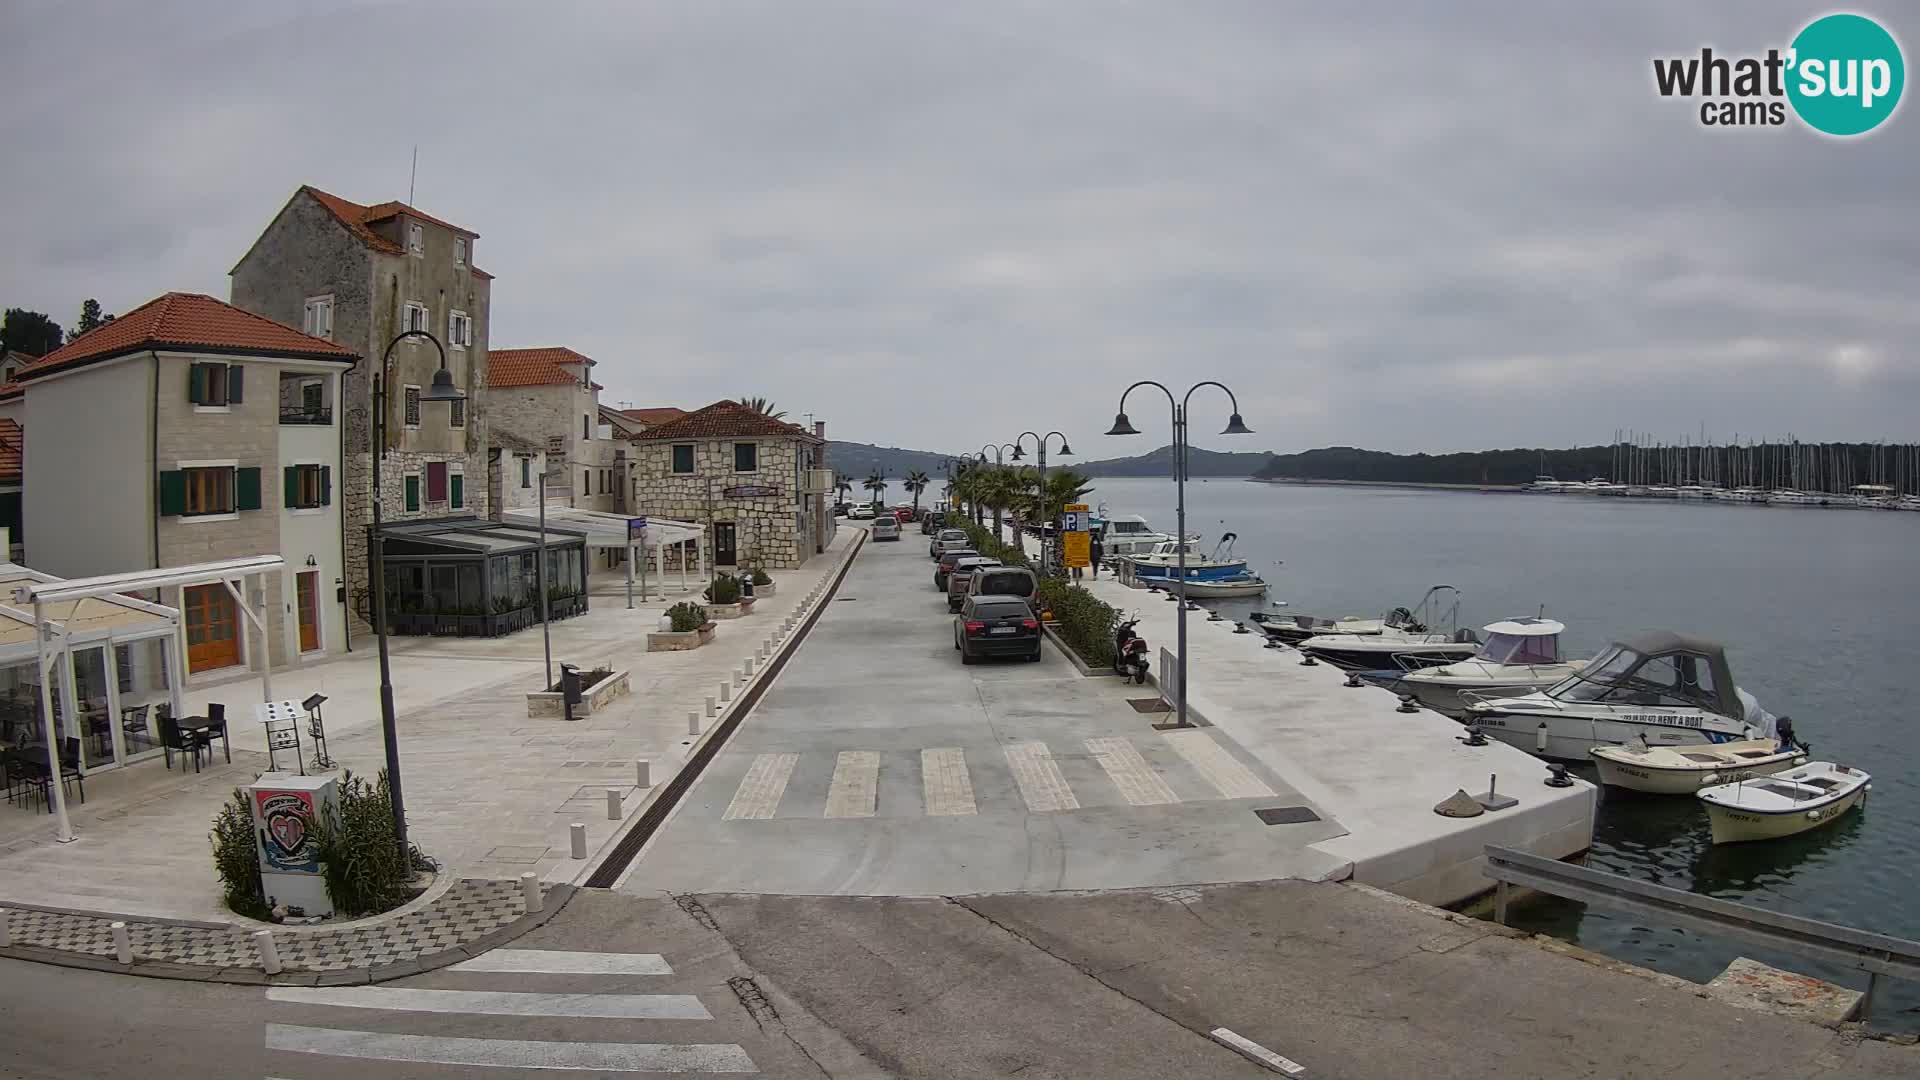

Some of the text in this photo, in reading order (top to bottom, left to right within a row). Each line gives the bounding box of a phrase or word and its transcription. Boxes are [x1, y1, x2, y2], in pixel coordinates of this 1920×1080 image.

[1066, 514, 1076, 530] P
[1657, 715, 1677, 726] RENT
[1678, 716, 1683, 726] A
[1684, 716, 1704, 729] BOAT
